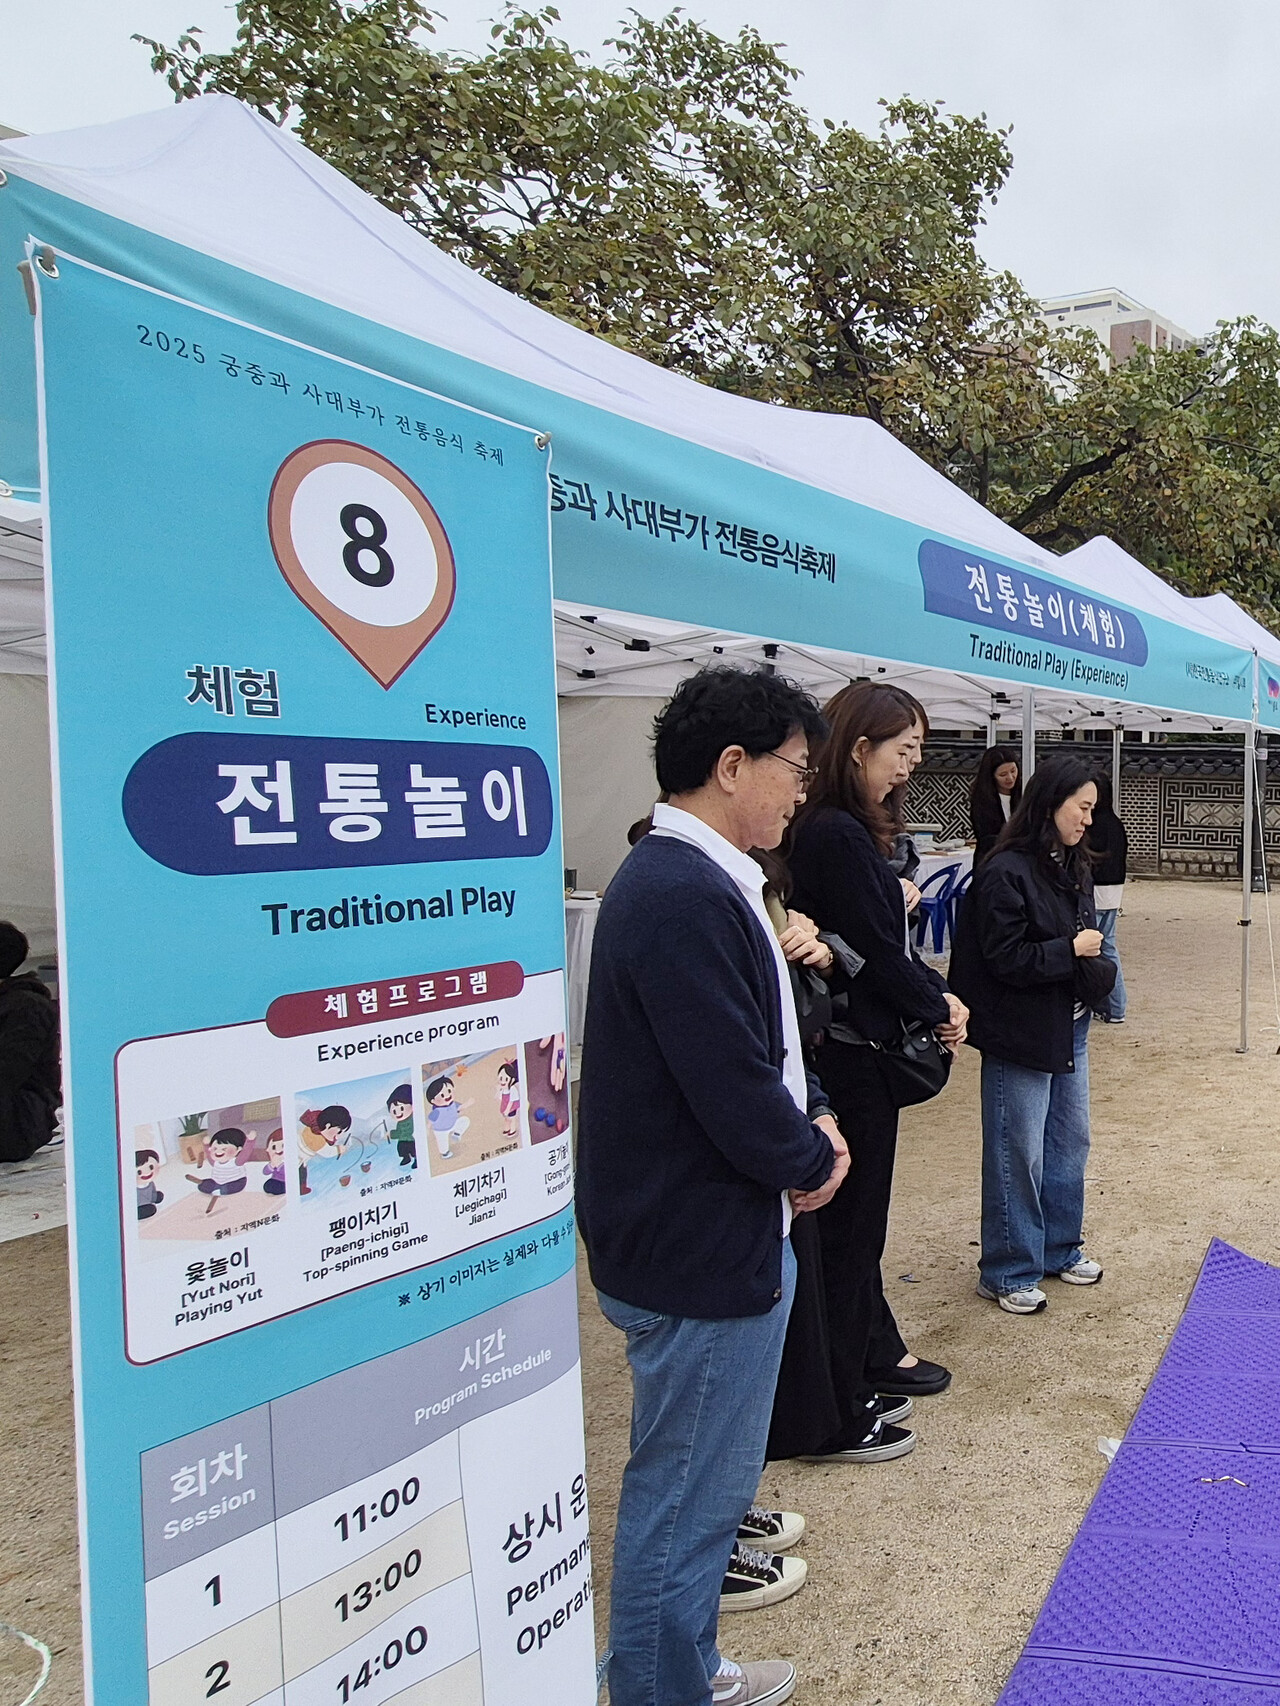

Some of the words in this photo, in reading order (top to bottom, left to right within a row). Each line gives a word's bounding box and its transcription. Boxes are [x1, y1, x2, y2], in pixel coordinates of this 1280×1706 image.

[137, 324, 205, 364] 2025
[218, 353, 291, 395] 궁중과
[302, 383, 385, 427] 사대부가
[395, 414, 464, 454] 전통음식
[474, 440, 504, 467] 축제
[339, 503, 395, 588] 8
[604, 490, 709, 551] 사대부가
[714, 520, 835, 584] 전통음식축제
[964, 563, 1125, 649] 전통놀이(체험)
[969, 633, 1042, 671] Traditional
[1044, 652, 1069, 681] Play
[1071, 658, 1128, 692] (Experience)
[185, 664, 281, 719] 체험
[424, 703, 527, 730] Experience
[215, 760, 528, 846] 전통놀이
[261, 888, 454, 936] Traditional
[460, 886, 516, 918] Play
[324, 970, 488, 1019] 체험프로그램
[317, 1028, 424, 1062] Experience
[429, 1015, 500, 1042] program
[329, 1201, 398, 1239] 팽이치기
[455, 1188, 507, 1218] [Jegichagi]
[468, 1207, 496, 1226] Jianzi
[185, 1247, 249, 1286] 윷놀이
[303, 1246, 389, 1283] Top-spinning
[391, 1234, 428, 1252] Game
[321, 1221, 409, 1263] [Paeng-ichigi]
[181, 1285, 215, 1309] [Yut
[219, 1272, 256, 1294] Nori]
[417, 1276, 445, 1301] 상기
[450, 1258, 500, 1286] 이미지는
[502, 1239, 538, 1266] 실제와
[174, 1299, 233, 1327] Playing
[237, 1288, 263, 1305] Yut
[458, 1327, 506, 1372] 시간
[414, 1381, 478, 1425] Program
[481, 1349, 552, 1389] Schedule
[169, 1442, 248, 1504] 회차
[163, 1487, 256, 1540] Session
[333, 1476, 420, 1542] 11:00
[502, 1491, 563, 1564] 상시
[204, 1574, 222, 1607] 1
[334, 1548, 422, 1623] 13:00
[205, 1659, 231, 1698] 2
[336, 1625, 428, 1704] 14:00
